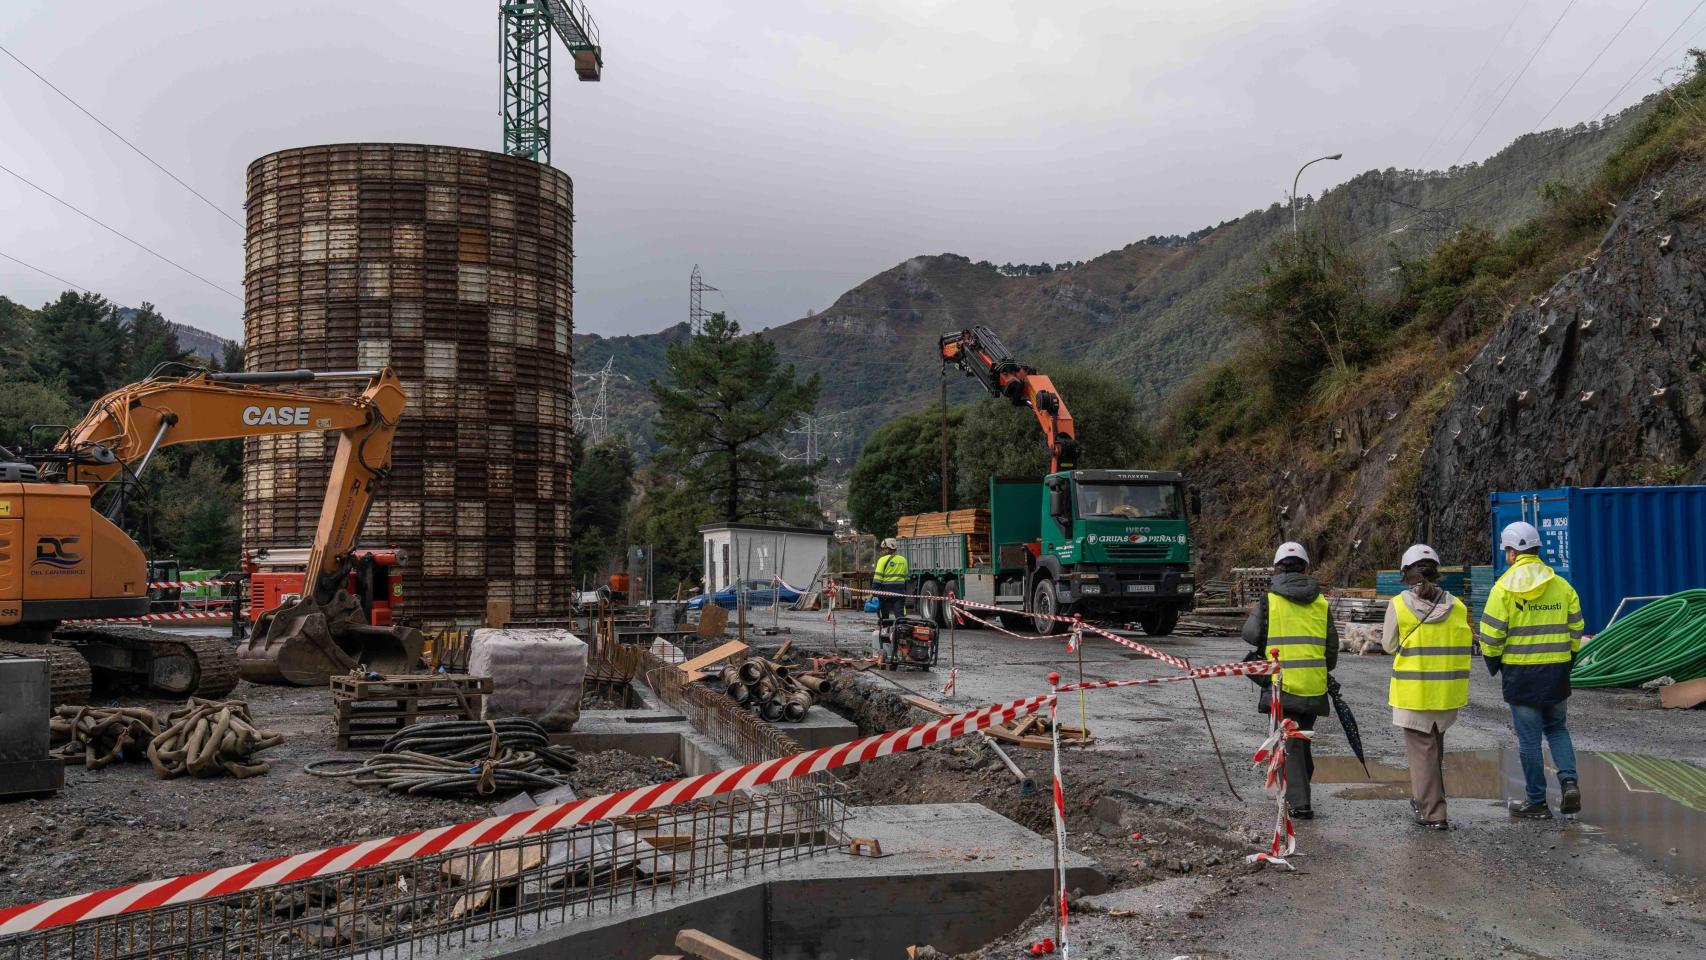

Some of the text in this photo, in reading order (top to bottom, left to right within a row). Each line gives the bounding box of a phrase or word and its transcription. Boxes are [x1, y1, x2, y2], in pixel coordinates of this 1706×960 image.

[242, 406, 311, 426] CASE
[1125, 526, 1151, 534] IVECO
[1528, 603, 1562, 612] Intxausti
